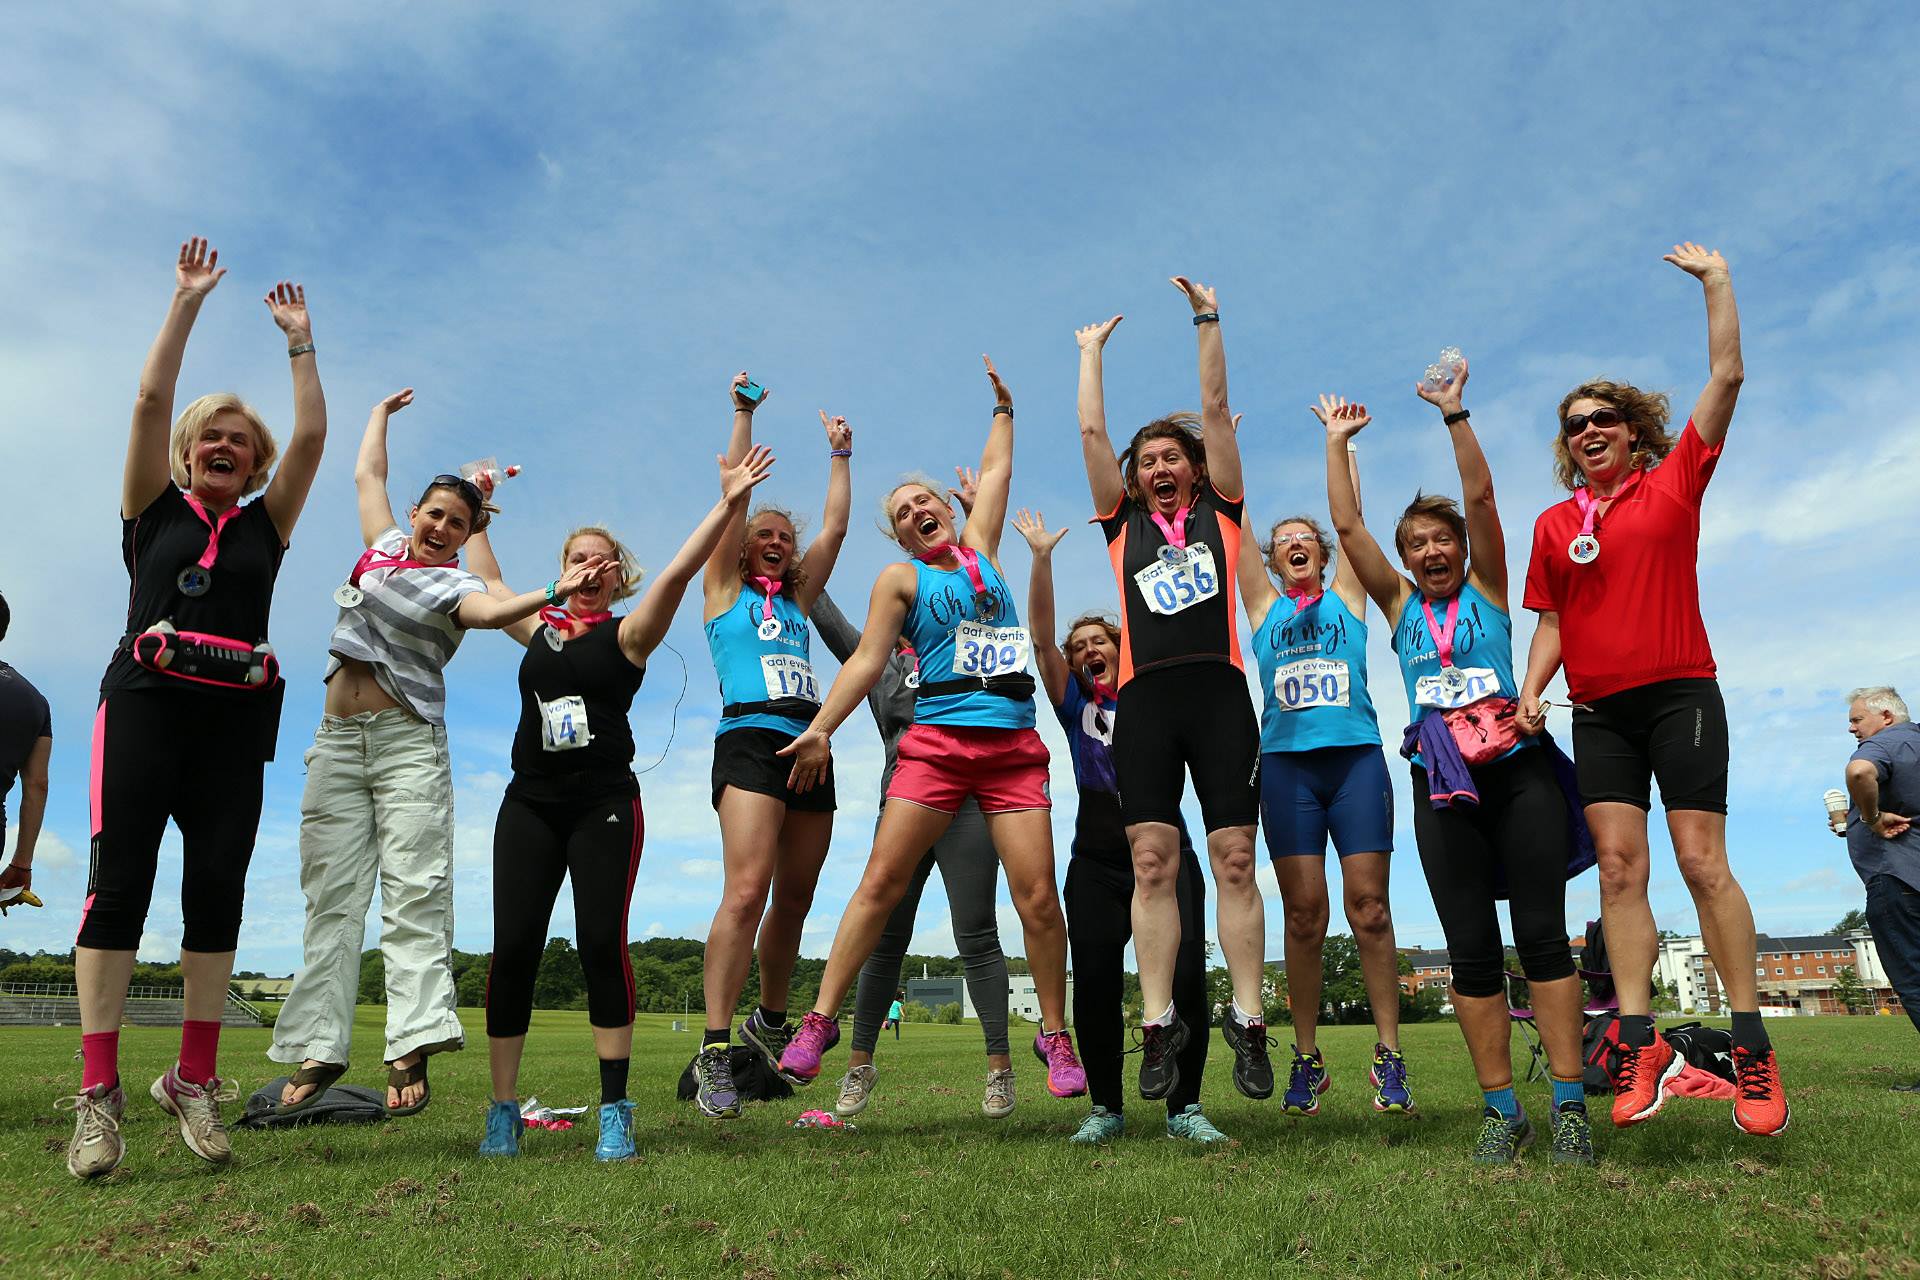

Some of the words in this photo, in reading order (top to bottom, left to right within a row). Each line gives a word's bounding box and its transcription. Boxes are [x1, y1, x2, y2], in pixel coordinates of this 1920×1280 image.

[1142, 565, 1164, 583] aat
[1153, 562, 1214, 611] 056
[962, 626, 982, 637] aat
[985, 629, 1025, 641] events
[962, 640, 1017, 675] 309
[1276, 643, 1322, 660] FITNESS
[1281, 663, 1299, 677] aat
[1303, 662, 1345, 671] events
[777, 670, 816, 699] 124
[1284, 673, 1339, 706] 050
